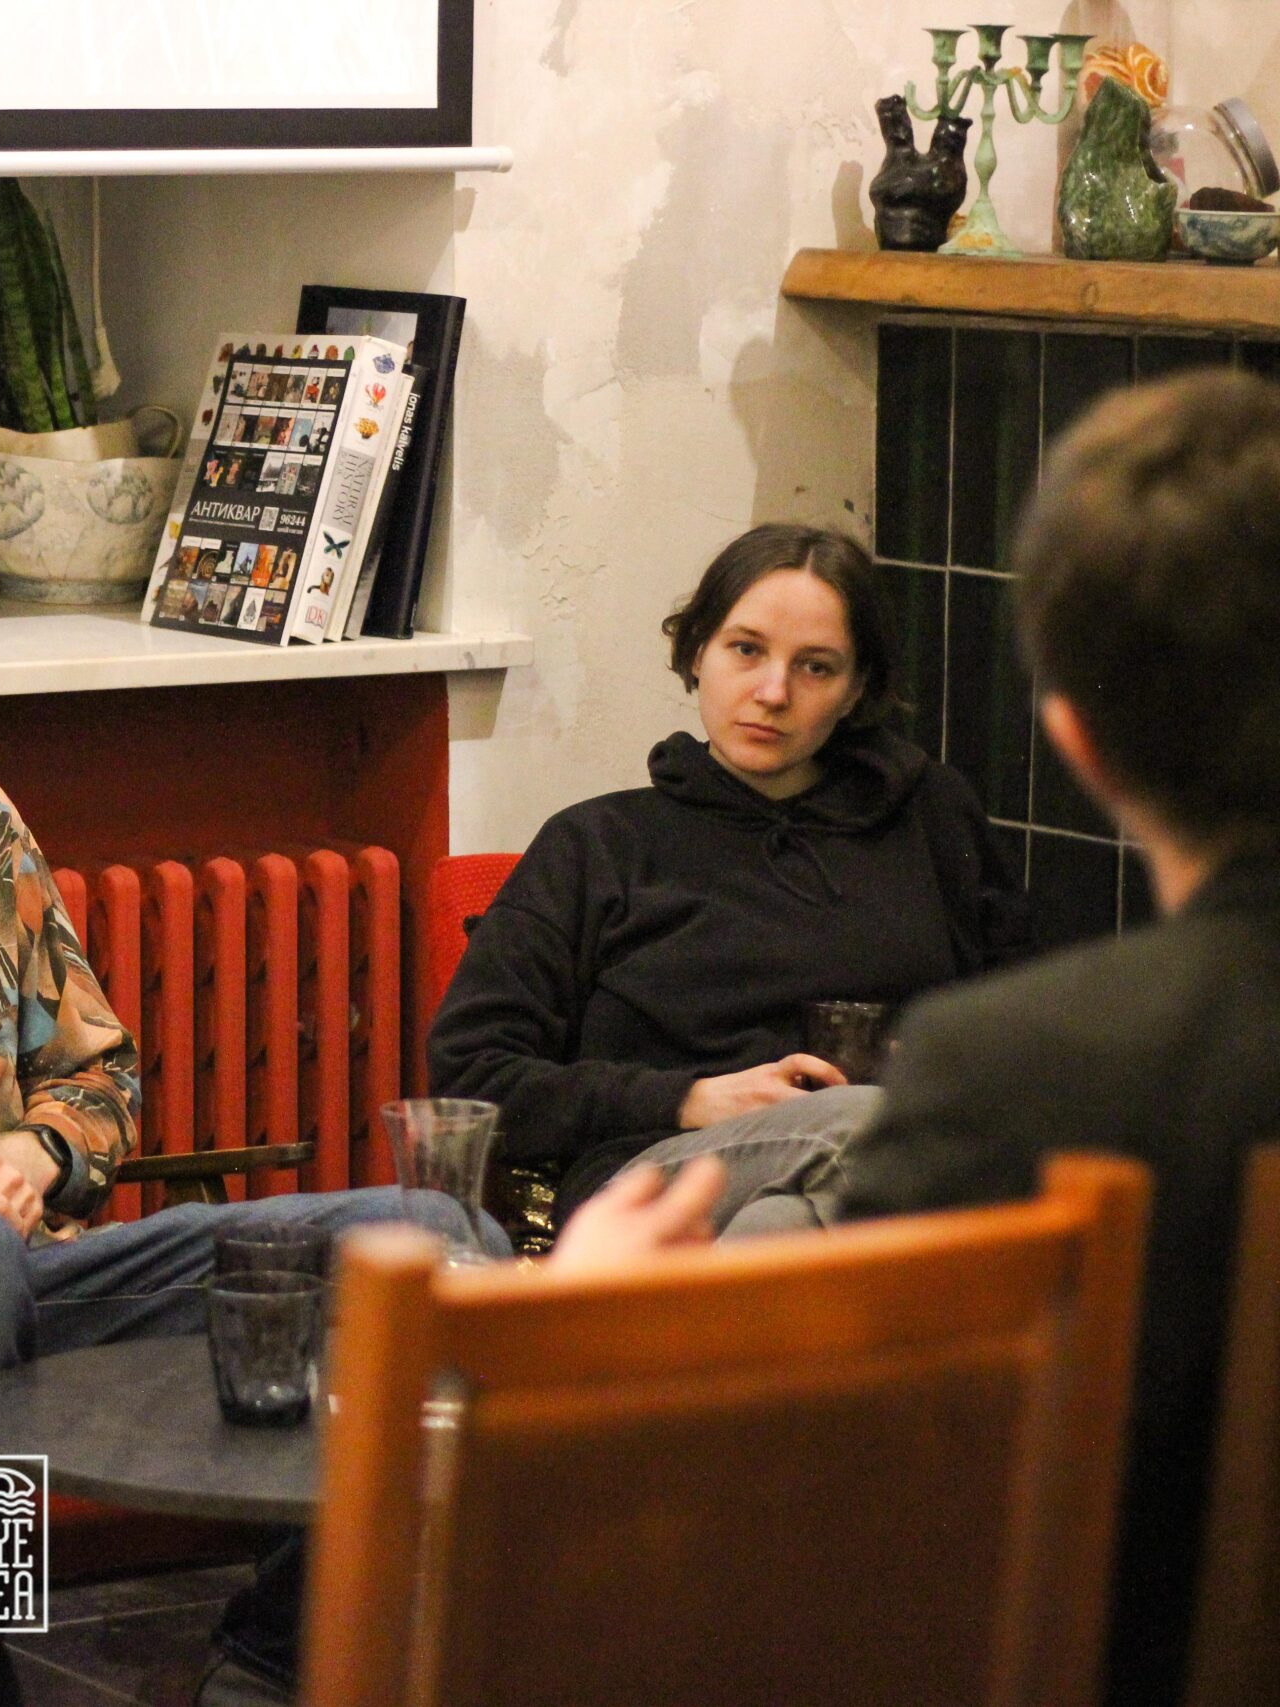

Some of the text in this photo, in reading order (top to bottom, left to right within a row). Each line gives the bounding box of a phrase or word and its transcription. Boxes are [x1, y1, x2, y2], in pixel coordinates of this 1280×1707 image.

[392, 425, 413, 471] kalvelis
[332, 453, 362, 521] HISTORY
[190, 500, 261, 522] АНТИКВАР
[279, 514, 306, 527] 96244
